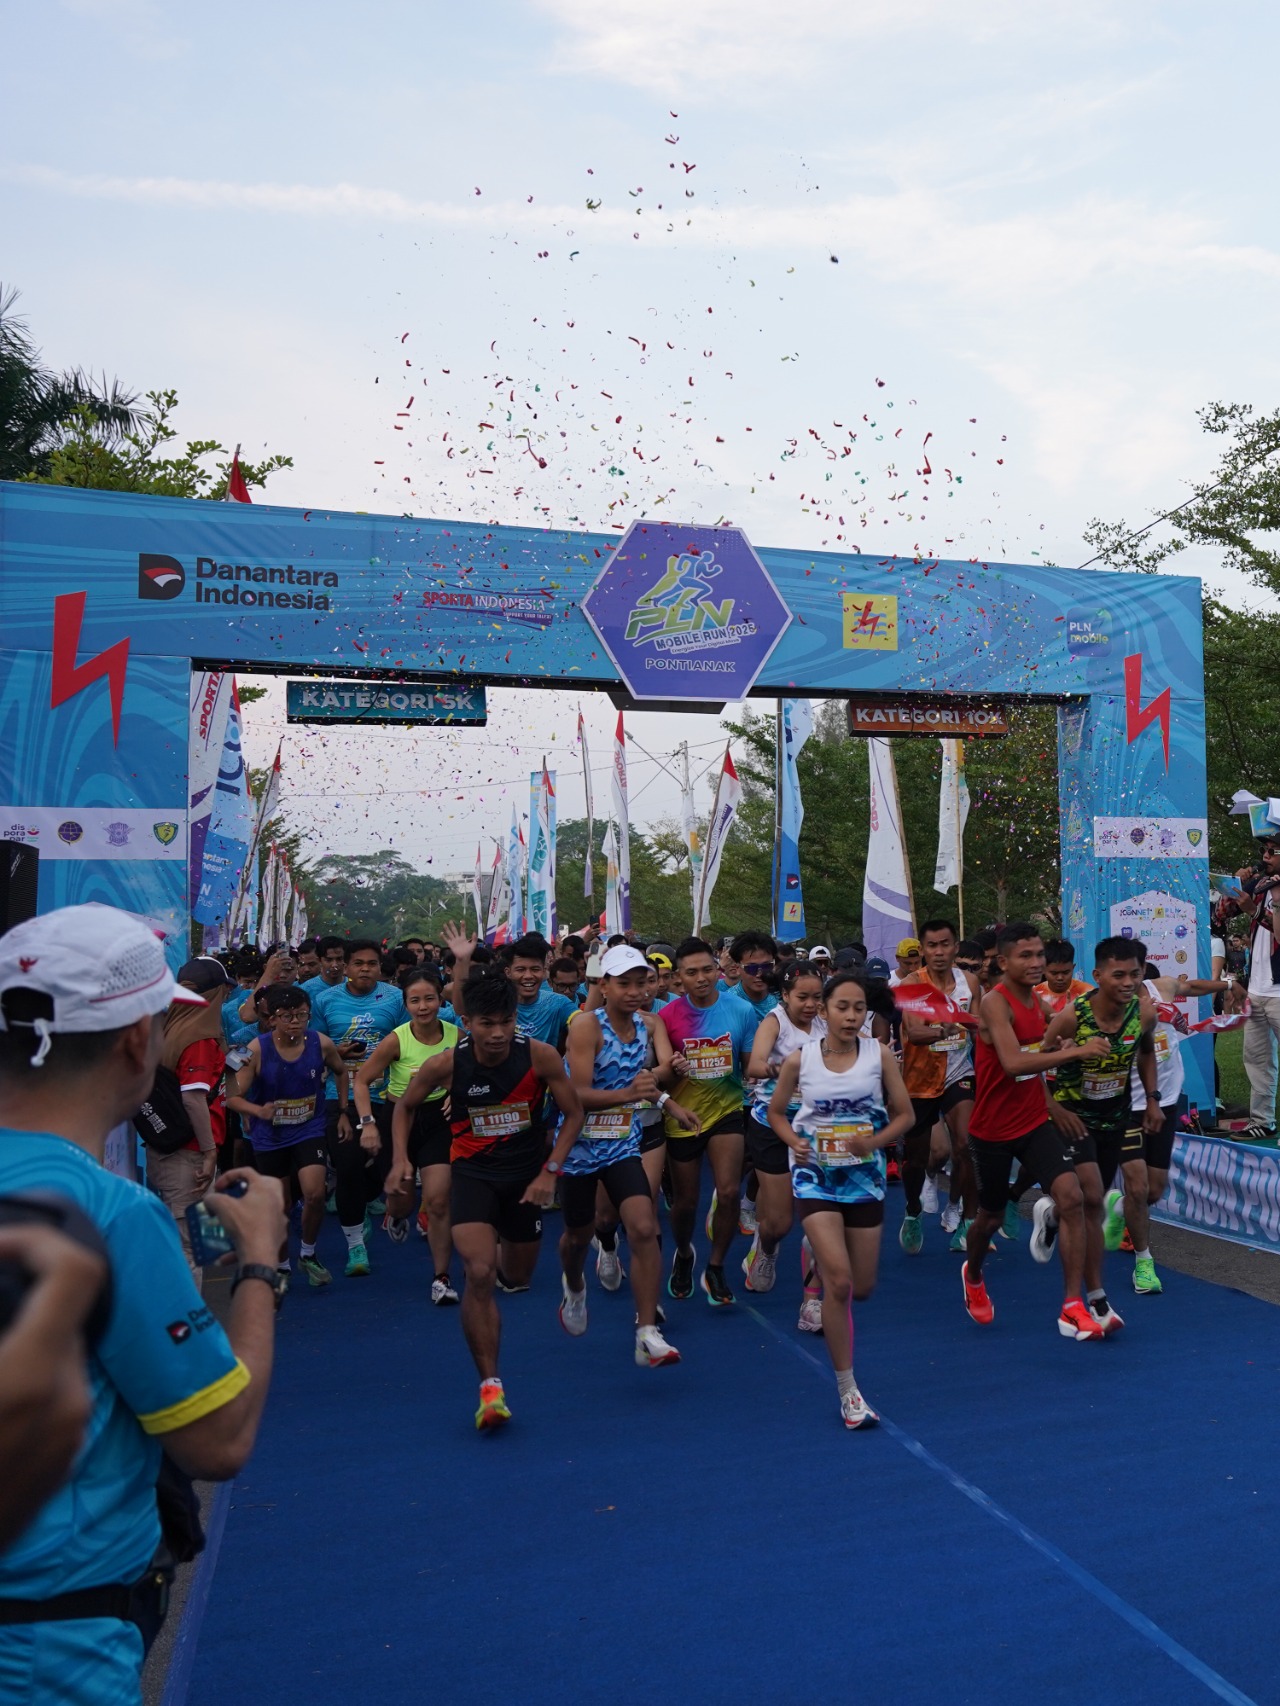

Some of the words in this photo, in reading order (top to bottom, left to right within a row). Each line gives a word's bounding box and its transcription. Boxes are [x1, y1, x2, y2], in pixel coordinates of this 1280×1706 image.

[196, 557, 339, 588] Danantara
[196, 582, 330, 611] Indonesia
[422, 592, 474, 606] SPORTA
[475, 596, 546, 612] INDONESIA
[624, 589, 735, 640] PLN
[1069, 621, 1092, 633] PLN
[655, 633, 701, 650] MOBILE
[704, 628, 728, 644] RUN
[730, 623, 757, 638] 2025
[1070, 632, 1109, 645] mobile
[645, 657, 736, 673] PONTIANAK
[302, 691, 434, 709] KATEGORI
[442, 694, 475, 711] 5K
[856, 708, 960, 725] KATEGORI
[967, 711, 1004, 726] 10K
[3, 830, 26, 838] pora
[10, 823, 26, 831] dis
[1140, 929, 1152, 937] BSI
[690, 1058, 699, 1069] M
[701, 1056, 726, 1068] 11252
[276, 1107, 284, 1116] M
[474, 1116, 485, 1126] M
[488, 1111, 520, 1125] 11190
[587, 1115, 596, 1125] M
[599, 1114, 624, 1125] 11103
[822, 1140, 829, 1151] F
[1184, 1140, 1239, 1231] RUN
